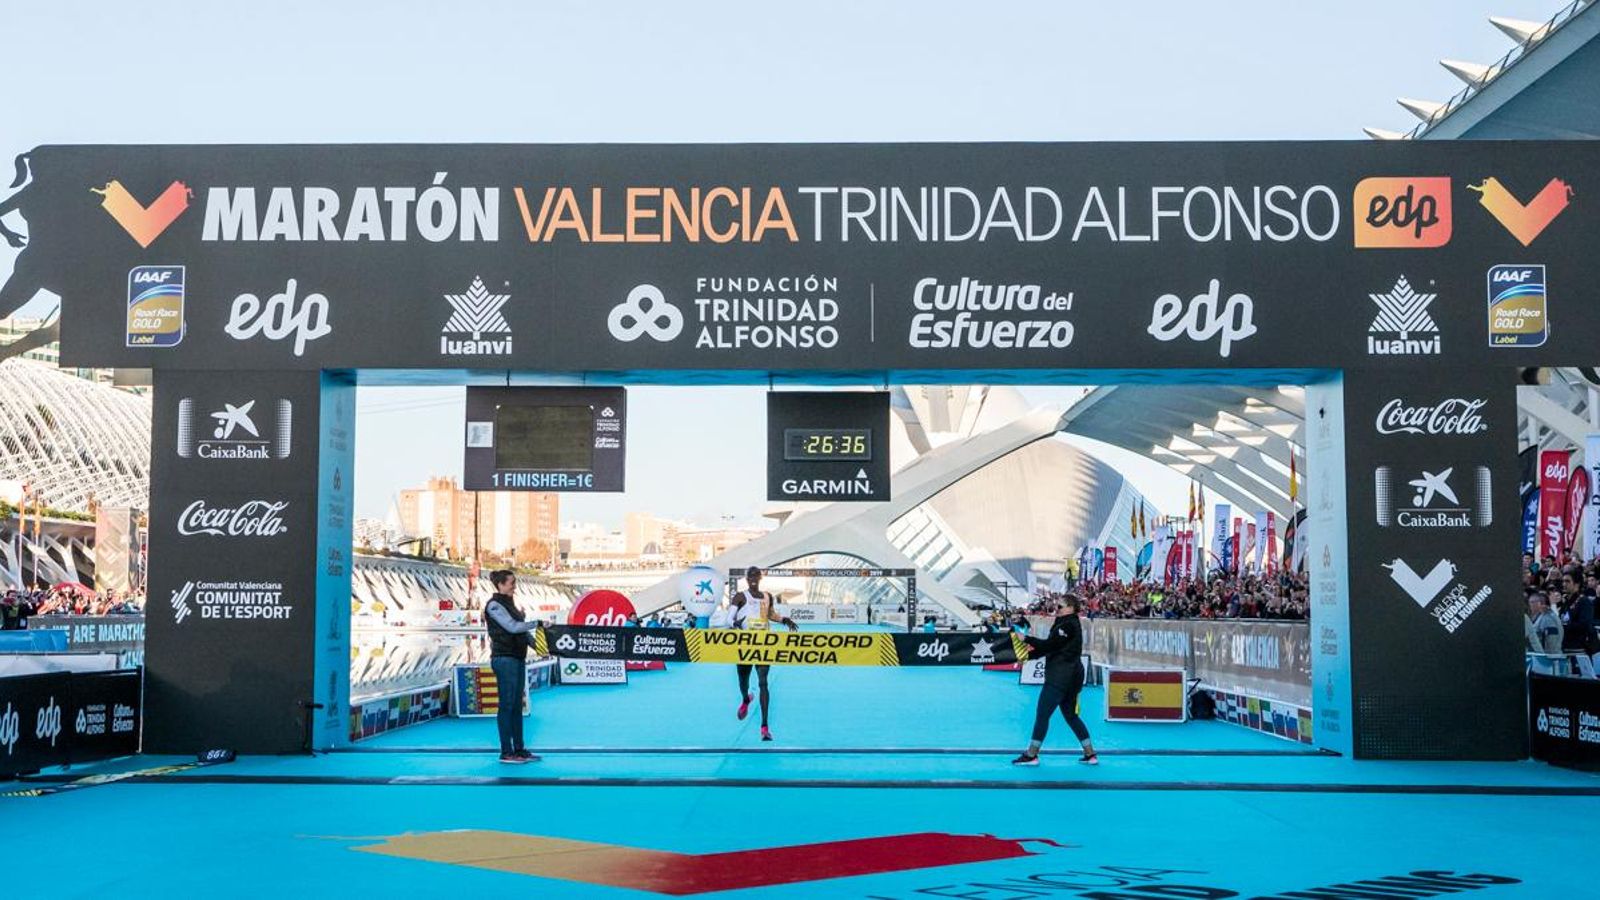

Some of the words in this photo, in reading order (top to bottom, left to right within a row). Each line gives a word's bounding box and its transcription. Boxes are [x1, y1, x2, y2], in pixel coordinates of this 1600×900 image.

[202, 172, 499, 242] MARATÓN
[514, 187, 798, 242] VALENCIA
[799, 186, 1062, 242] TRINIDAD
[1072, 185, 1340, 242] ALFONSO
[1366, 186, 1439, 238] edp
[134, 271, 172, 283] IAAF
[697, 274, 838, 293] FUNDACIÓN
[1493, 270, 1532, 282] IAAF
[913, 277, 1041, 311] Cultura
[1043, 292, 1073, 311] del
[225, 278, 331, 356] edp
[695, 299, 838, 321] TRINIDAD
[1147, 278, 1257, 357] edp
[1496, 307, 1518, 317] Road
[1519, 307, 1541, 317] Race
[133, 318, 161, 330] GOLD
[909, 314, 1074, 348] Esfuerzo
[1494, 318, 1524, 329] GOLD
[132, 335, 155, 344] Label
[441, 336, 513, 354] luanvi
[696, 326, 838, 349] ALFONSO
[1367, 335, 1441, 354] luanvi
[1494, 336, 1518, 344] Label
[1376, 398, 1488, 434] Coca-Cola
[198, 443, 270, 459] CaixaBank
[492, 473, 499, 486] 1
[1545, 460, 1567, 483] edp
[178, 500, 289, 536] Coca-Cola
[1397, 512, 1471, 527] CaixaBank
[196, 581, 238, 590] Comunitat
[239, 581, 282, 590] Valenciana
[195, 591, 282, 605] COMUNITAT
[1430, 583, 1468, 618] VALENCIA
[201, 605, 221, 618] DE
[1439, 595, 1468, 625] CIUDAD
[1445, 616, 1463, 633] DEL
[74, 625, 95, 643] ARE
[578, 638, 617, 646] TRINIDAD
[634, 635, 668, 645] Cultura
[704, 632, 779, 646] WORLD
[785, 635, 873, 649] RECORD
[632, 644, 676, 655] Esfuerzo
[738, 649, 838, 664] VALENCIA
[917, 638, 949, 661] edp
[36, 696, 62, 747] edp
